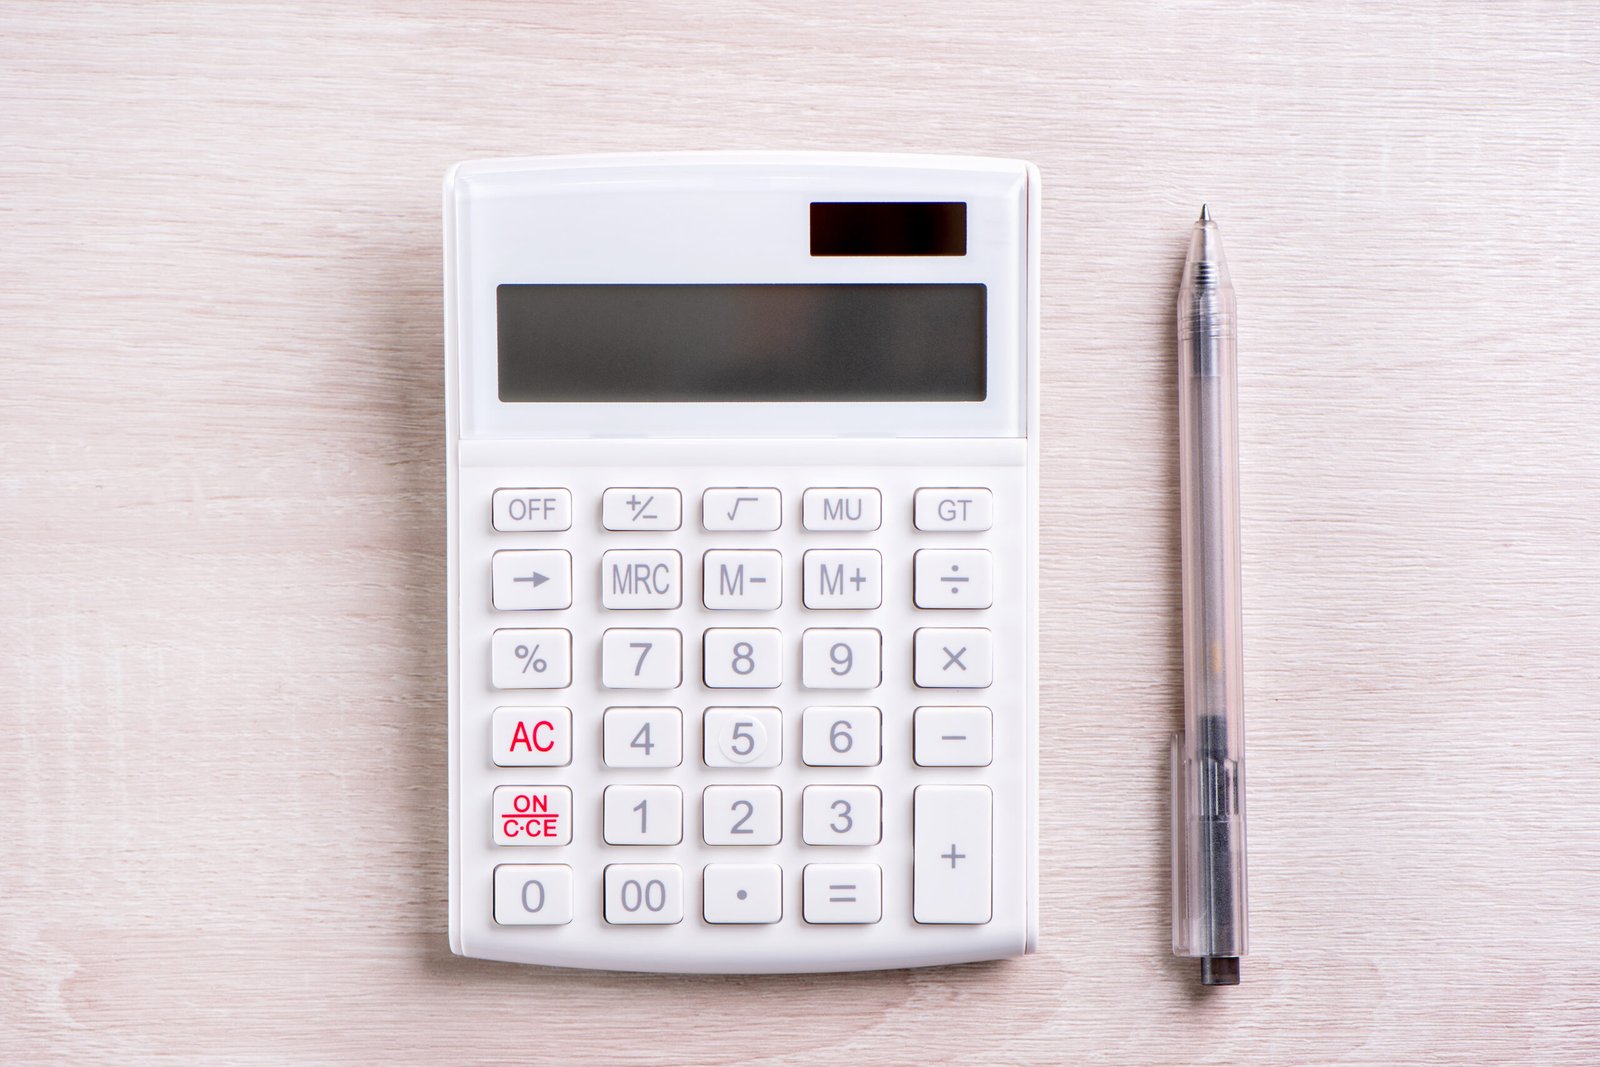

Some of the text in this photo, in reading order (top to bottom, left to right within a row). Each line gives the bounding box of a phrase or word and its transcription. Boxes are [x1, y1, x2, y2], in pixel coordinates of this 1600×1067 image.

[509, 499, 556, 520] OFF
[823, 499, 861, 520] MU
[938, 499, 972, 521] GT
[613, 563, 669, 594] MRC
[720, 564, 766, 595] M-
[820, 564, 866, 595] M+
[515, 644, 547, 673] %
[630, 643, 652, 676] 7
[732, 642, 754, 675] 8
[830, 643, 852, 676] 9
[509, 720, 555, 752] AC
[630, 722, 654, 755] 4
[732, 722, 754, 755] 5
[830, 720, 852, 753] 6
[513, 794, 547, 811] ON
[633, 800, 647, 833] 1
[730, 800, 753, 834] 2
[830, 800, 852, 833] 3
[522, 880, 545, 913] 0
[621, 880, 665, 912] 00
